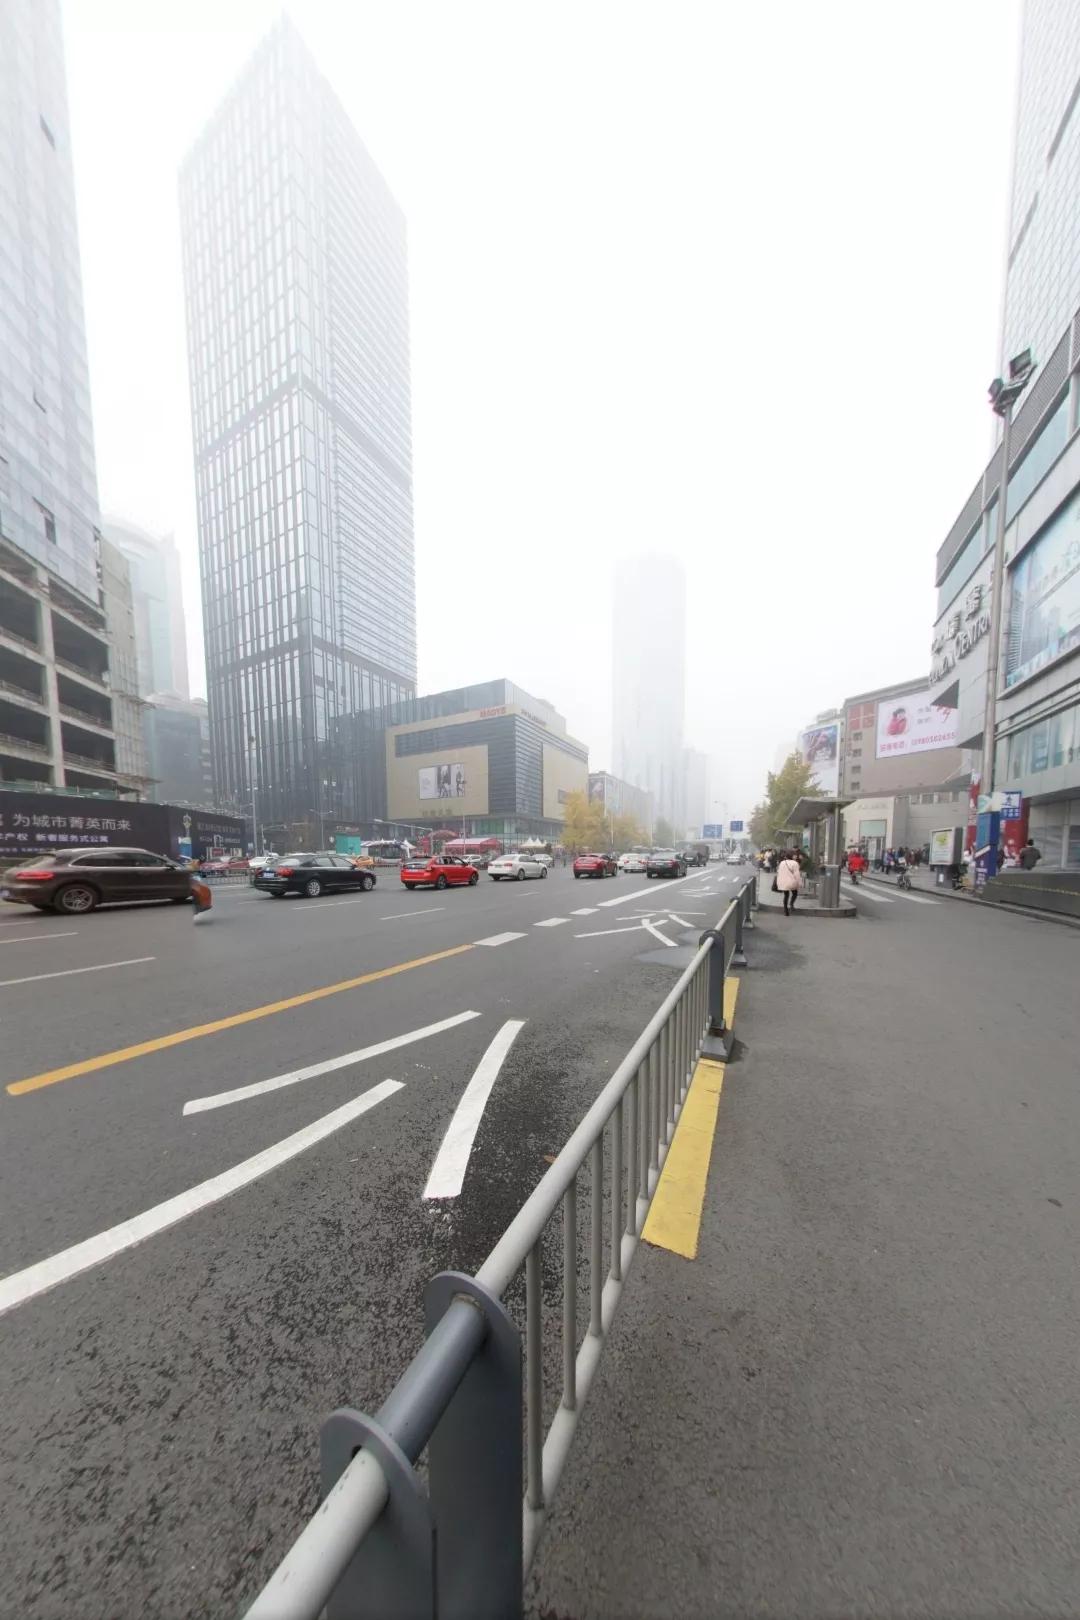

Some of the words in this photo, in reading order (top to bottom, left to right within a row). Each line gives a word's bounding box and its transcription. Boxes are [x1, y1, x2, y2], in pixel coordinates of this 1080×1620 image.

[13, 813, 132, 831] 为城市菁英而来
